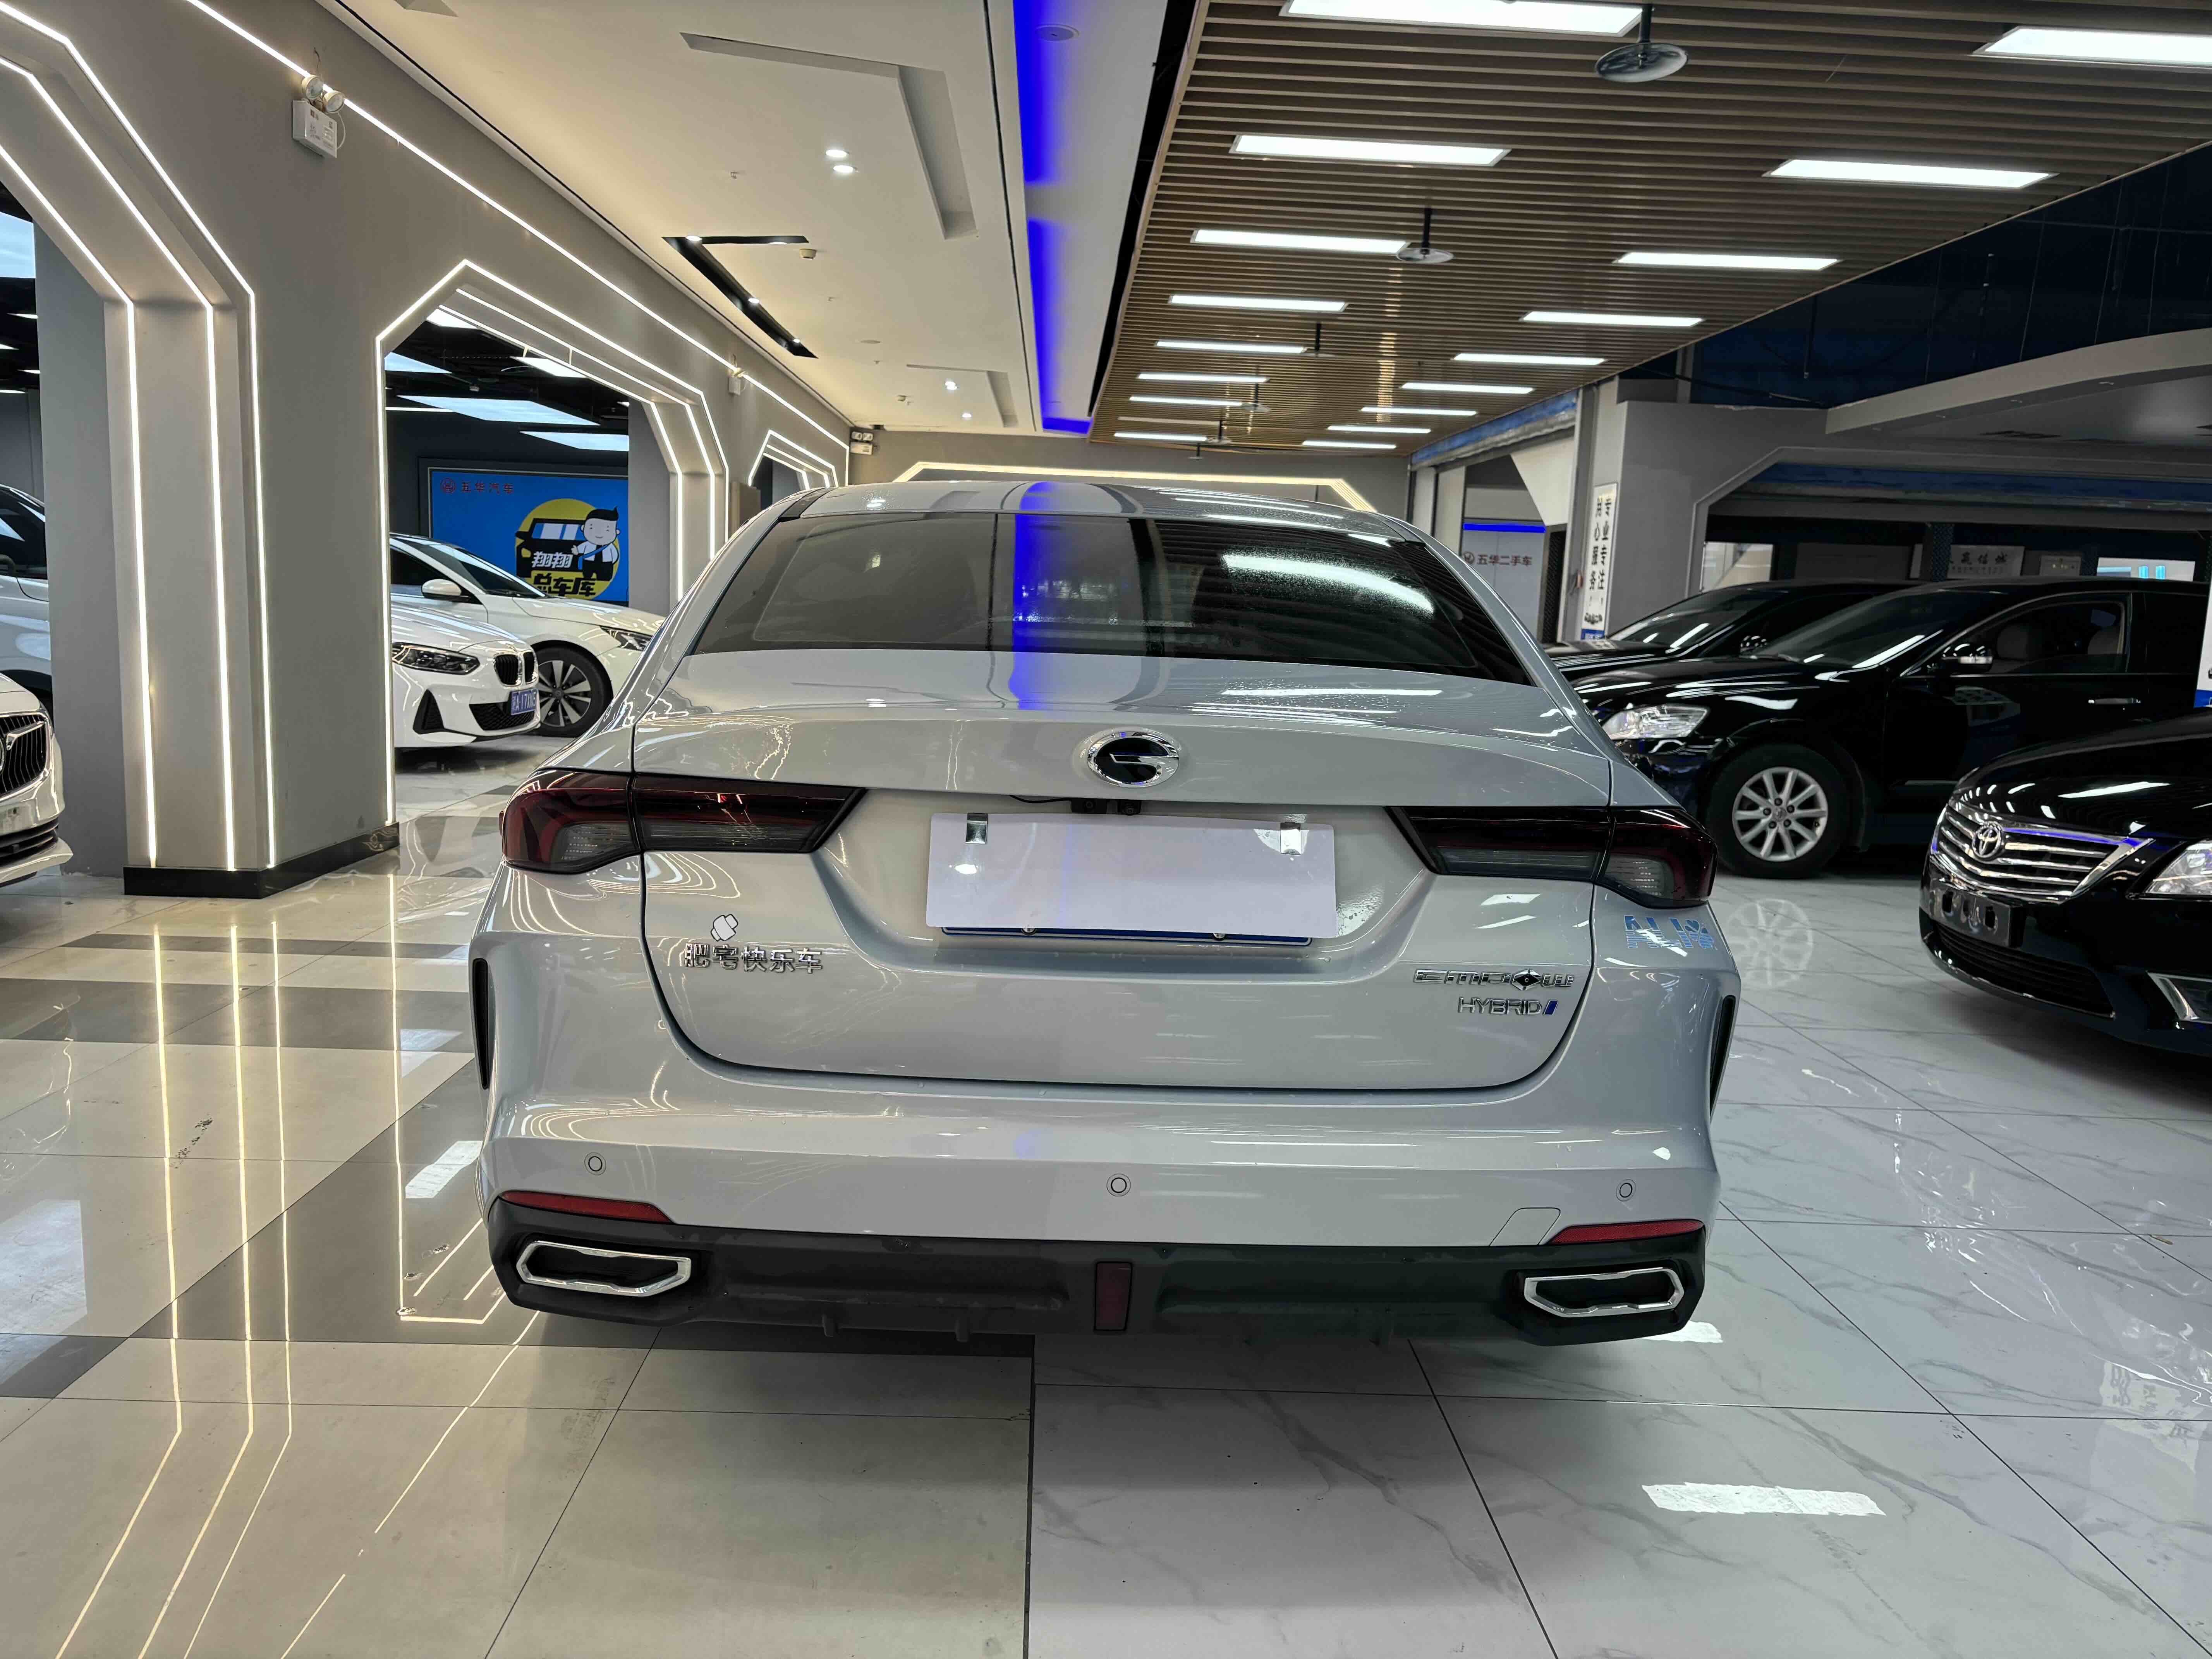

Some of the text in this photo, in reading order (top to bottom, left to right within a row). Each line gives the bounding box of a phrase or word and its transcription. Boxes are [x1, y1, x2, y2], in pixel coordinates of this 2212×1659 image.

[531, 551, 574, 568] 翔翔
[1477, 554, 1532, 566] 五华二手车
[534, 573, 596, 597] 总车库
[684, 942, 823, 974] 肥宅快乐车
[1458, 996, 1542, 1015] HYBRID
